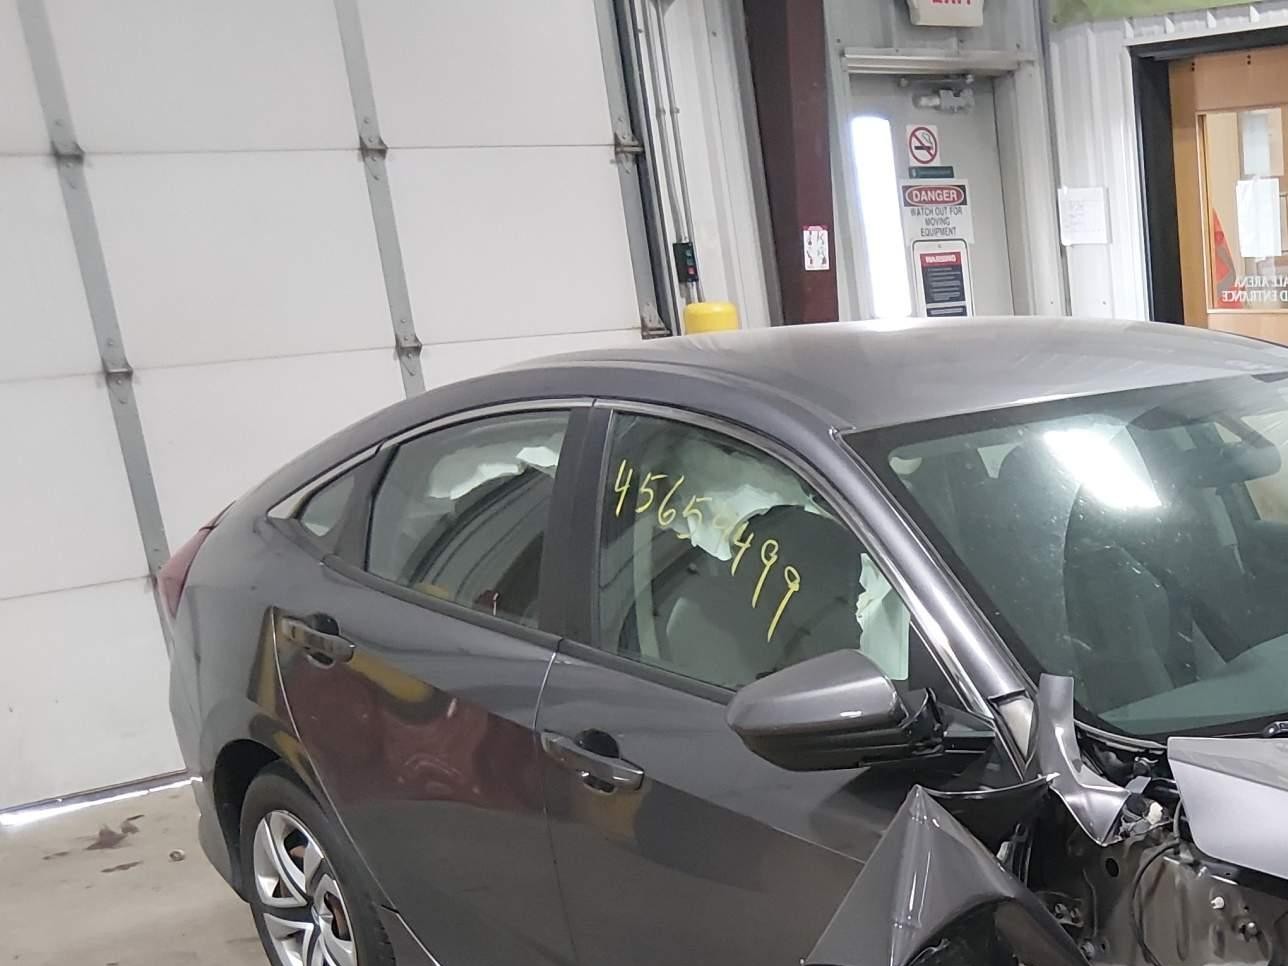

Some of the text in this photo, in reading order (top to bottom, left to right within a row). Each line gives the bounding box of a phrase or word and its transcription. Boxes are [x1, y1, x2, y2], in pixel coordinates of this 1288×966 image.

[912, 189, 958, 202] DANGER
[910, 207, 934, 217] WATCH
[935, 206, 948, 216] OUT
[924, 216, 951, 227] MOVING
[920, 226, 957, 237] EQUIPMENT
